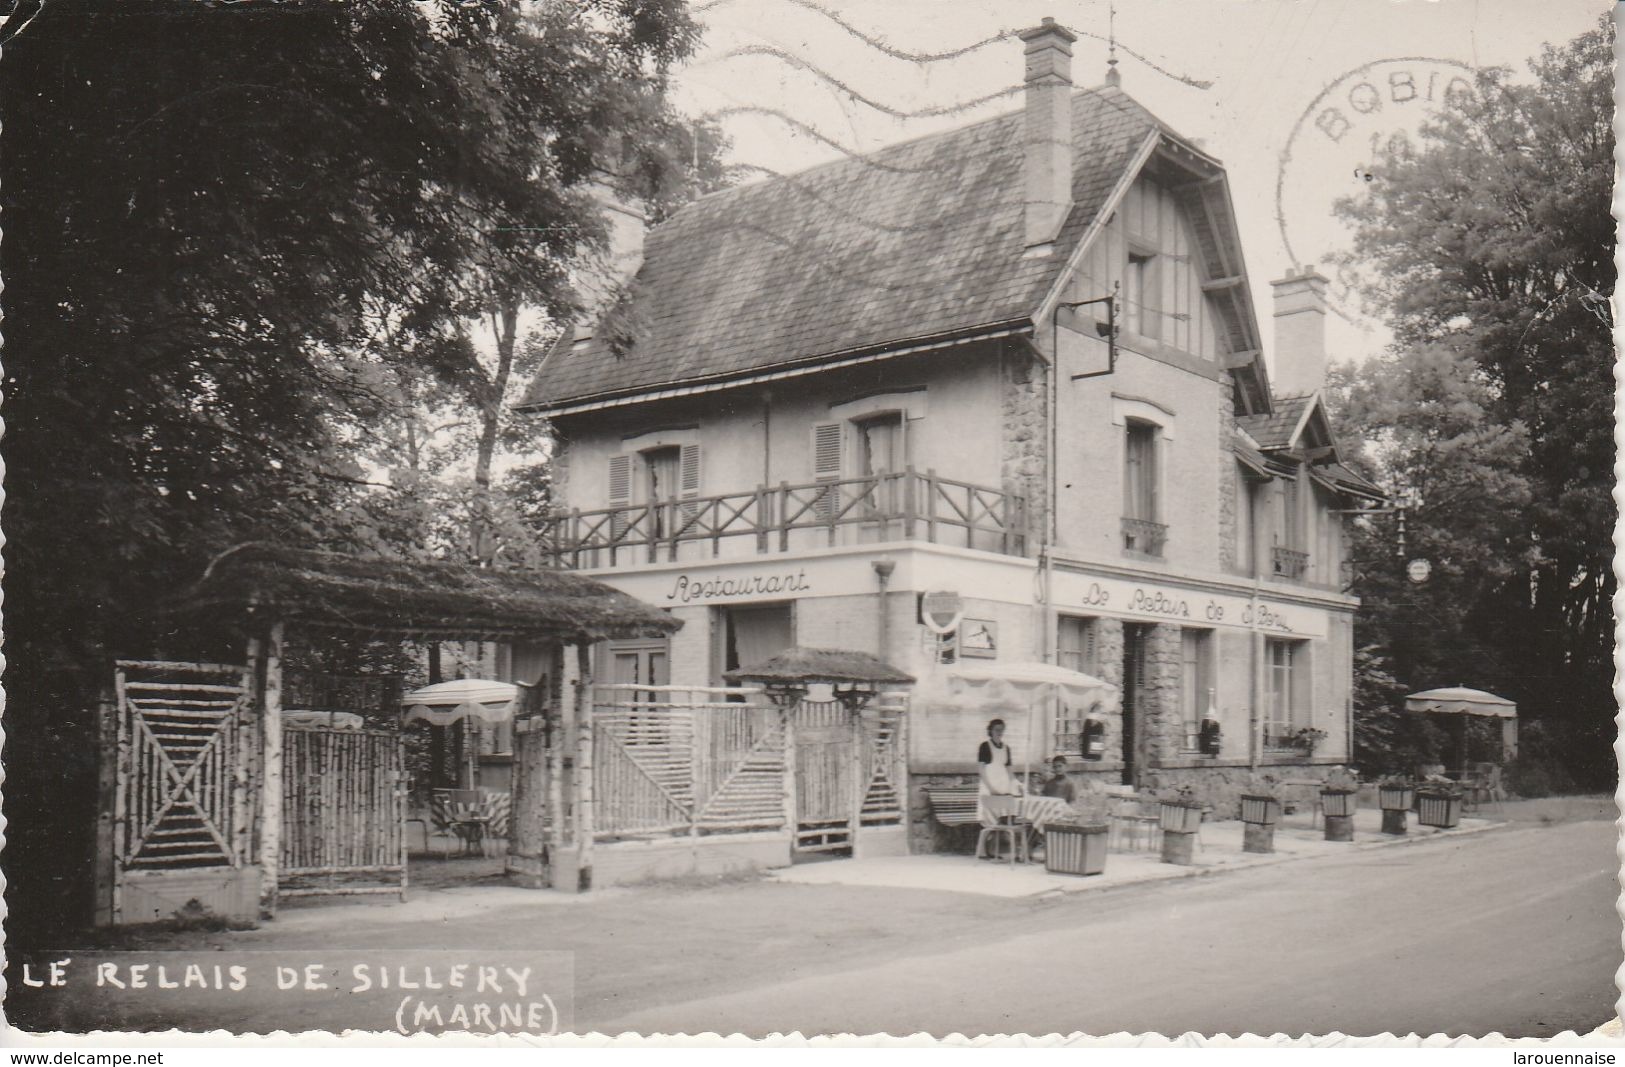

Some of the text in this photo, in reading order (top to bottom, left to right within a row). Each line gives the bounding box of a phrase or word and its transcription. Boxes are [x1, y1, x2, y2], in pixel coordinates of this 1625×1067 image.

[666, 568, 810, 602] Restaurant
[1082, 582, 1110, 606] Le
[1127, 588, 1190, 617] Relais
[1205, 599, 1225, 620] de
